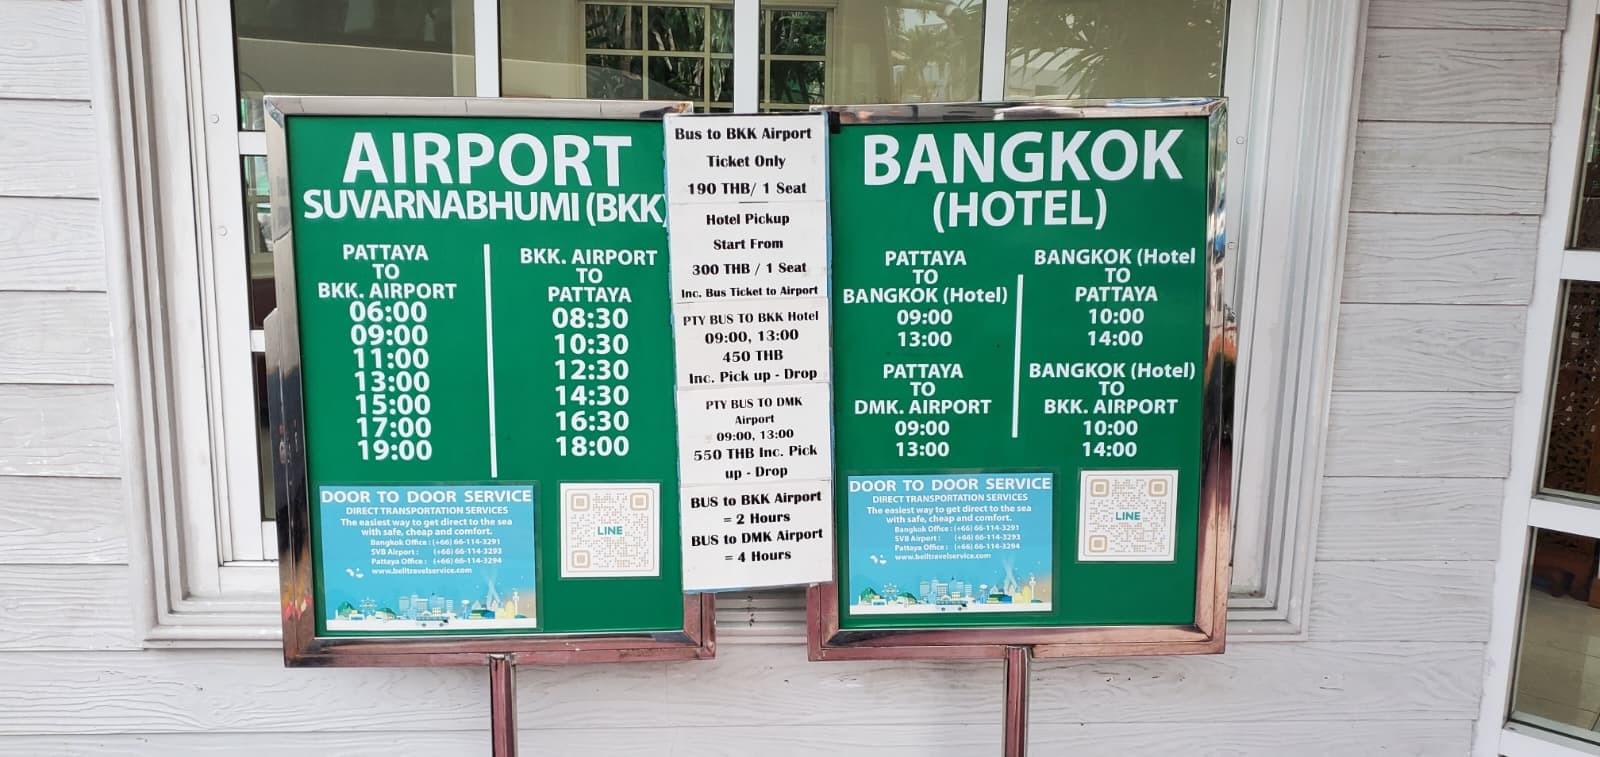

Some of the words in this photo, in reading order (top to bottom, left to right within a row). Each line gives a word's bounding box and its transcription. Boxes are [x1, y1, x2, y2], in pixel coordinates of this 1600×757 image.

[675, 128, 702, 140] Bus
[707, 129, 721, 139] to
[727, 128, 757, 139] BKK
[762, 128, 811, 142] Airport
[343, 132, 632, 186] AIRPORT
[707, 155, 749, 167] Ticket
[755, 155, 786, 169] Only
[864, 129, 1183, 185] BANGKOK
[688, 183, 716, 194] 190
[721, 183, 756, 196] THB/
[764, 183, 768, 194] 1
[777, 183, 806, 194] Seat
[304, 189, 579, 221] SUVARNABHUMI
[934, 189, 1106, 233] (HOTEL)
[706, 214, 740, 225] Hotel
[745, 213, 789, 226] Pickup
[343, 244, 428, 260] PATTAYA
[714, 240, 745, 250] Start
[751, 239, 783, 249] From
[521, 248, 566, 264] BKK.
[572, 249, 657, 265] AIRPORT
[886, 250, 966, 266] PATTAYA
[1035, 249, 1132, 265] BANGKOK
[1137, 248, 1195, 266] (Hotel
[372, 263, 400, 279] TO
[576, 268, 602, 283] TO
[693, 264, 719, 275] 300
[723, 264, 750, 274] THB
[767, 263, 772, 273] 1
[779, 263, 806, 273] Seat
[912, 269, 938, 284] TO
[1105, 268, 1130, 283] TO
[318, 282, 364, 298] BKK.
[369, 283, 457, 299] AIRPORT
[548, 286, 632, 302] PATTAYA
[682, 289, 701, 298] Inc.
[706, 289, 726, 297] Bus
[730, 287, 762, 296] Ticket
[781, 286, 818, 296] Airport
[844, 288, 938, 303] BANGKOK
[944, 287, 1007, 304] (Hotel)
[1076, 286, 1158, 302] PATTAYA
[350, 301, 427, 322] 06:00
[552, 307, 628, 328] 08:30
[683, 316, 705, 326] PTY
[710, 314, 733, 325] BUS
[738, 313, 753, 323] TO
[758, 312, 783, 322] BKK
[788, 311, 818, 321] Hotel
[897, 309, 952, 325] 09:00
[1089, 308, 1144, 324] 10:00
[351, 324, 428, 345] 09:00
[705, 332, 751, 344] 09:00,
[758, 329, 798, 341] 13:00
[898, 331, 952, 347] 13:00
[1088, 330, 1143, 346] 14:00
[555, 333, 628, 354] 10:30
[353, 348, 429, 369] 11:00
[723, 351, 750, 362] 450
[756, 350, 783, 361] THB
[555, 359, 629, 380] 12:30
[689, 373, 714, 384] Inc.
[720, 371, 749, 382] Pick
[754, 372, 771, 383] up
[784, 369, 817, 380] Drop
[884, 364, 963, 378] PATTAYA
[1030, 363, 1125, 378] BANGKOK
[1131, 362, 1195, 380] (Hotel)
[355, 371, 430, 392] 13:00
[910, 382, 935, 396] TO
[1099, 381, 1124, 396] TO
[556, 385, 629, 405] 14:30
[356, 394, 430, 415] 15:00
[706, 400, 725, 410] PTY
[731, 399, 753, 409] BUS
[758, 398, 772, 407] TO
[777, 397, 802, 406] DMK
[855, 400, 904, 414] DMK.
[909, 400, 992, 414] AIRPORT
[1045, 399, 1088, 414] BKK.
[1093, 399, 1178, 414] AIRPORT
[357, 417, 431, 438] 17:00
[556, 411, 629, 431] 16:30
[736, 415, 774, 426] Airport
[1084, 420, 1138, 435] 10:00
[717, 432, 755, 441] 09:00,
[760, 429, 794, 439] 13:00
[895, 421, 949, 436] 09:00
[358, 440, 432, 460] 19:00
[556, 436, 629, 456] 18:00
[694, 450, 722, 461] 550
[726, 448, 754, 459] THB
[760, 447, 783, 457] Inc.
[789, 445, 817, 456] Pick
[896, 442, 949, 456] 13:00
[1083, 442, 1137, 457] 14:00
[726, 470, 742, 480] up
[756, 466, 787, 478] Drop
[850, 480, 896, 492] DOOR
[903, 480, 924, 491] TO
[932, 478, 978, 491] DOOR
[986, 478, 1051, 490] SERVICE
[321, 491, 370, 503] DOOR
[377, 491, 399, 503] TO
[407, 491, 456, 503] DOOR
[464, 490, 531, 502] SERVICE
[691, 497, 718, 508] BUS
[723, 497, 736, 506] to
[742, 494, 770, 505] BKK
[775, 491, 821, 504] Airport
[905, 494, 984, 503] TRANSPORTATION
[986, 493, 1028, 501] SERVICES
[346, 507, 379, 515] DIRECT
[380, 507, 464, 515] TRANSPORTATION
[465, 506, 508, 514] SERVICES
[1116, 512, 1140, 520] LINE
[340, 518, 357, 526] The
[359, 518, 391, 526] easiest
[423, 519, 439, 528] get
[440, 518, 468, 526] direct
[480, 518, 495, 526] the
[736, 514, 744, 525] 2
[750, 513, 790, 524] Hours
[361, 528, 381, 536] with
[406, 528, 433, 537] cheap
[454, 527, 492, 535] comfort.
[598, 526, 623, 535] LINE
[692, 535, 718, 546] BUS
[724, 535, 736, 544] to
[742, 532, 772, 543] DMK
[777, 529, 823, 542] Airport
[738, 552, 745, 562] 4
[752, 551, 791, 561] Hours
